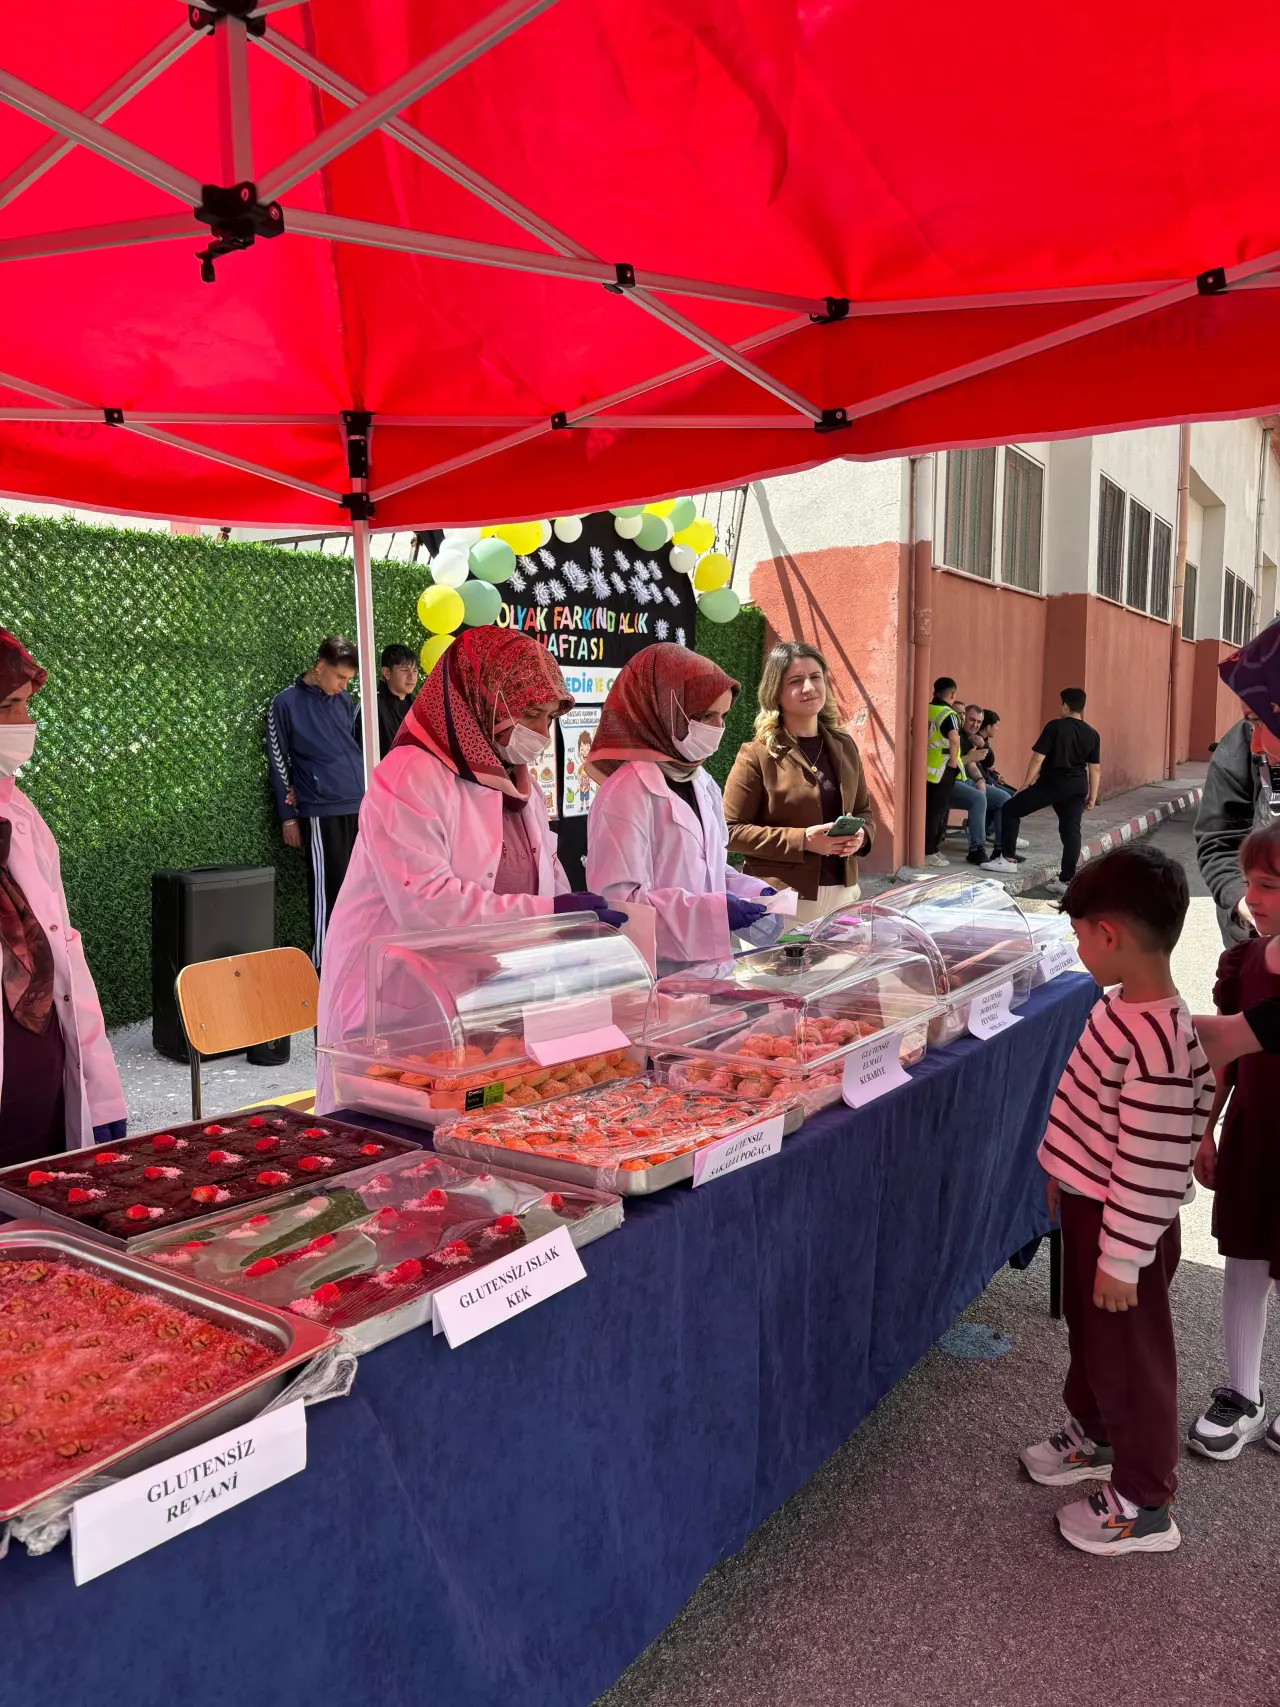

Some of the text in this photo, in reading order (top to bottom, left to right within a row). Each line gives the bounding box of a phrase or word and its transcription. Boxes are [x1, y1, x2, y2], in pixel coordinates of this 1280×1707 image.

[496, 602, 548, 633] OLYAK
[565, 671, 593, 693] EDİR
[594, 676, 604, 693] VE
[861, 1040, 890, 1059] GLUTENSİZ
[859, 1066, 887, 1086] KURABİYE
[862, 1055, 883, 1071] ELMALI
[725, 1131, 764, 1157] GLUTENSİZ
[709, 1143, 771, 1177] SAKALLI POĞAÇA
[459, 1245, 560, 1309] GLUTENSİZ ISLAK
[505, 1286, 533, 1309] KEK
[147, 1438, 256, 1504] GLUTENSİZ
[166, 1473, 239, 1524] REVANİ
